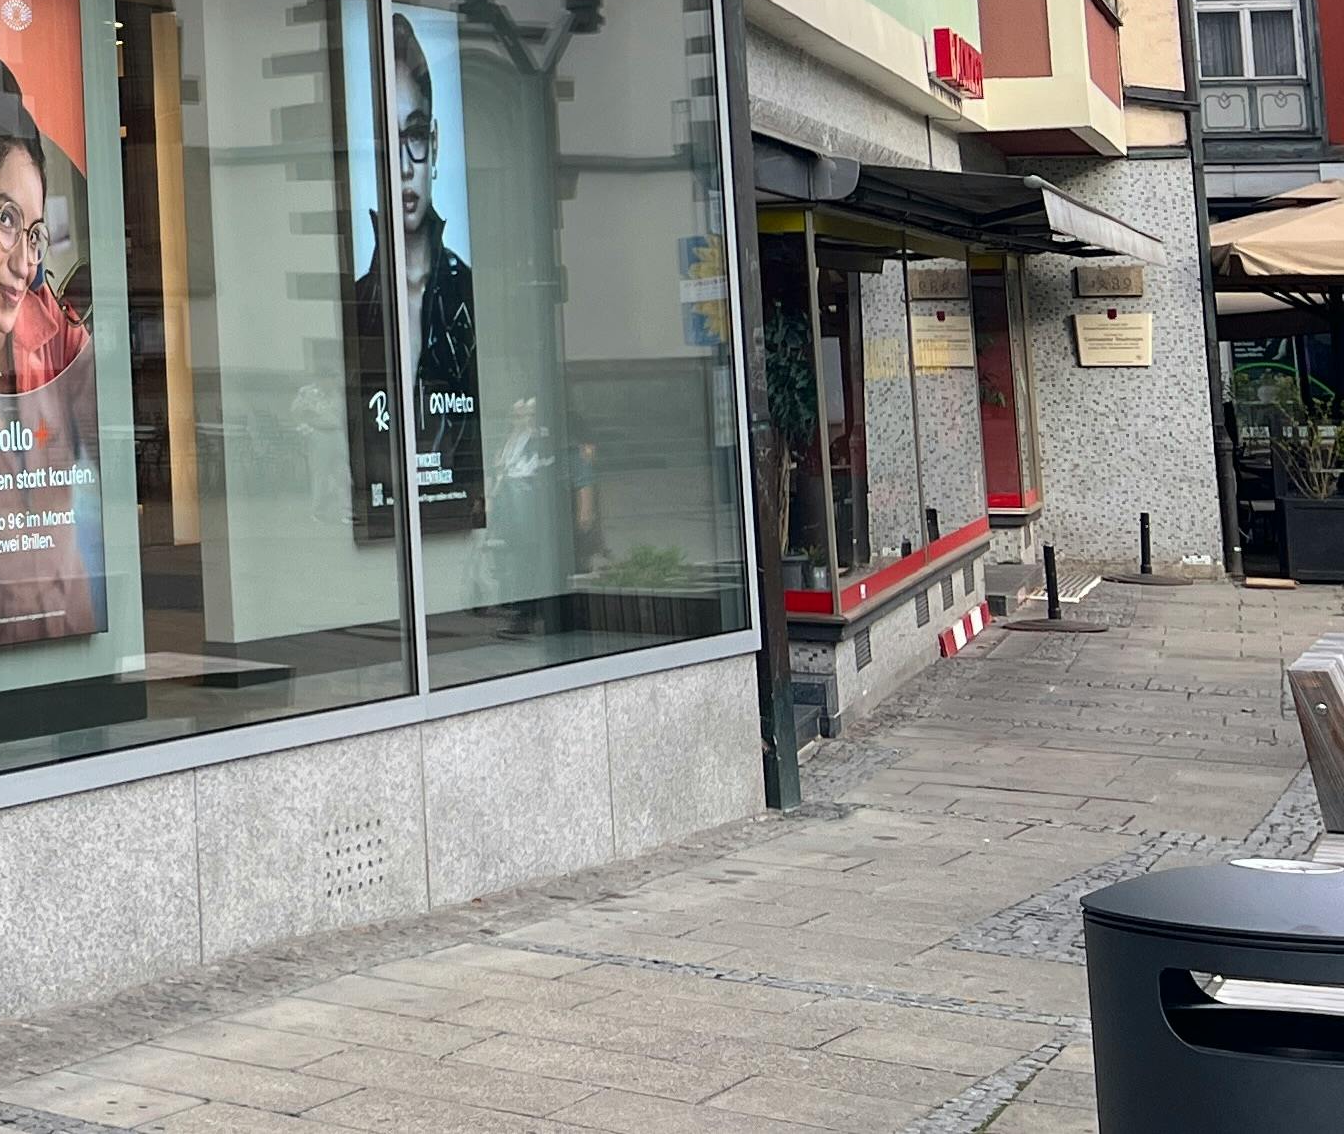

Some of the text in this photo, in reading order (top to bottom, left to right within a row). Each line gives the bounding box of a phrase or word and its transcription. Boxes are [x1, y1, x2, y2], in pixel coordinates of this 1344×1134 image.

[444, 392, 474, 413] Meta
[16, 468, 47, 490] statt
[48, 464, 96, 486] kaufen.
[26, 511, 41, 528] im
[42, 509, 76, 527] Monat
[21, 533, 56, 550] Brillen.
